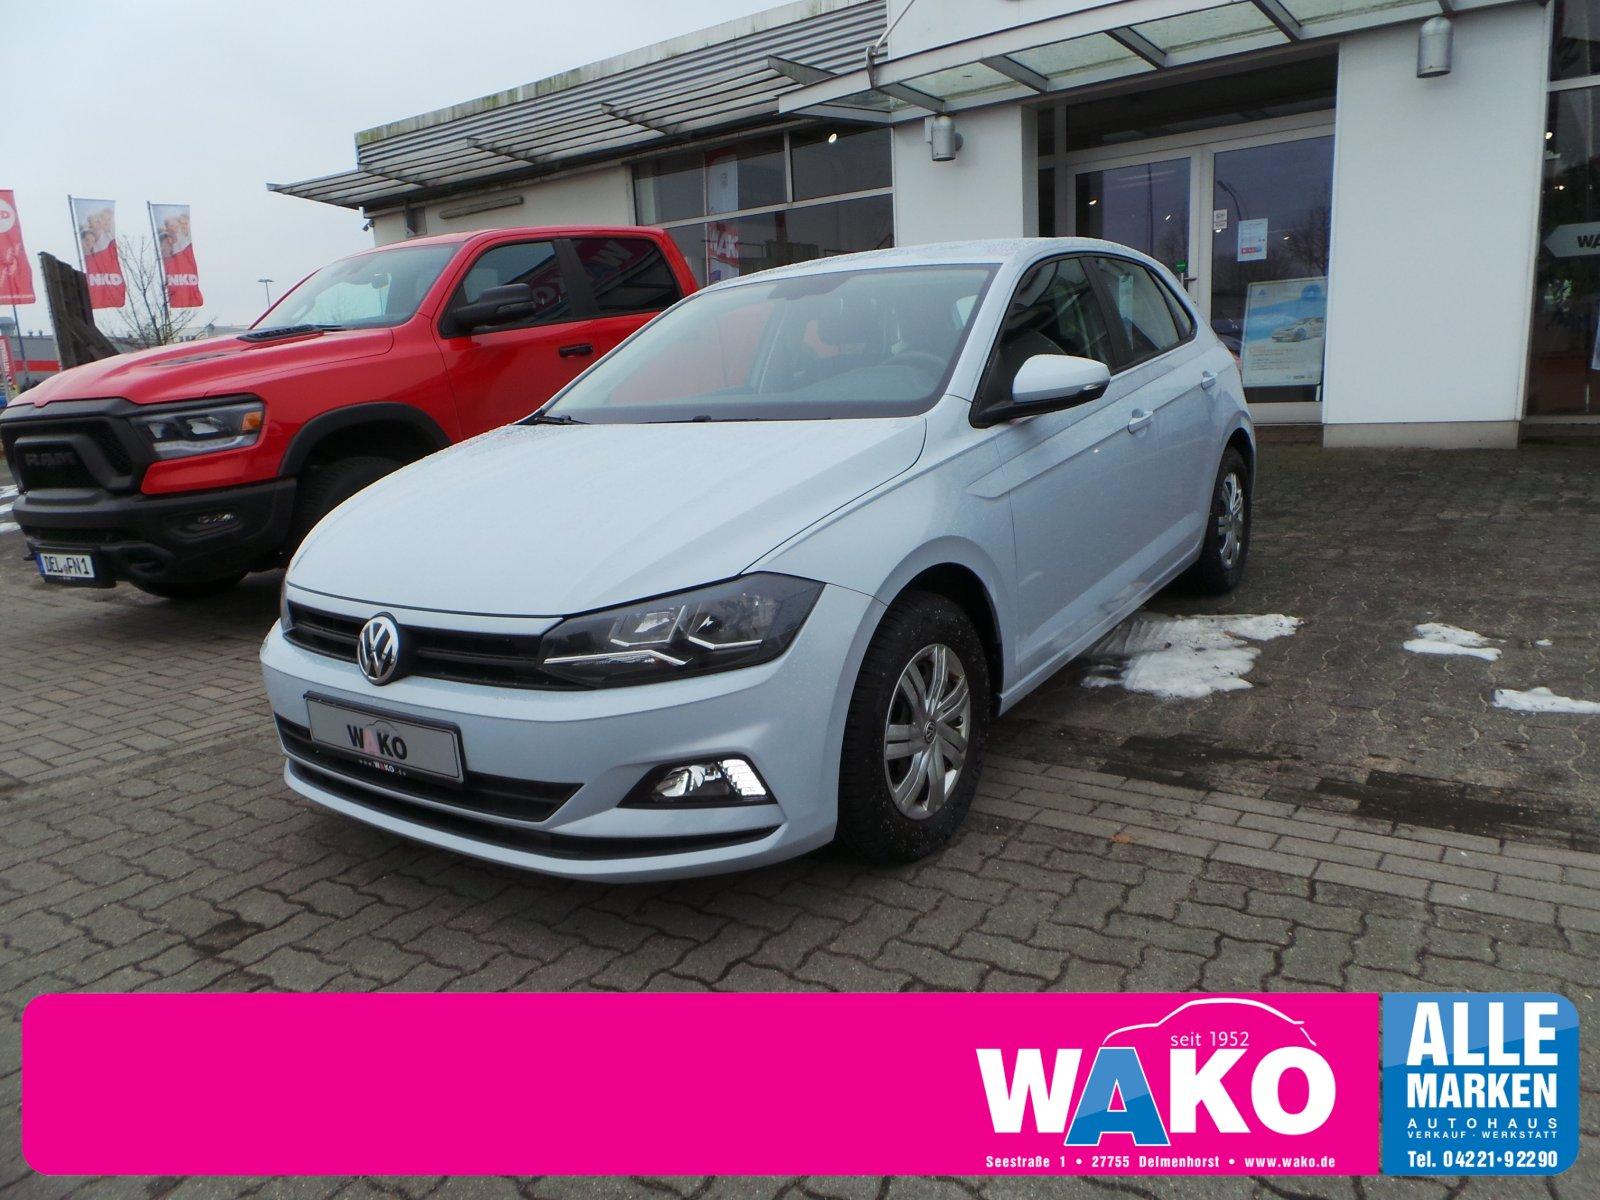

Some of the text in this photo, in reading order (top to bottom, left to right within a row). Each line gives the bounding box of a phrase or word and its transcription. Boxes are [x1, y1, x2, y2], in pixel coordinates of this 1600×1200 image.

[89, 273, 123, 286] NKD
[167, 274, 199, 286] NKD
[347, 724, 408, 760] WAKO
